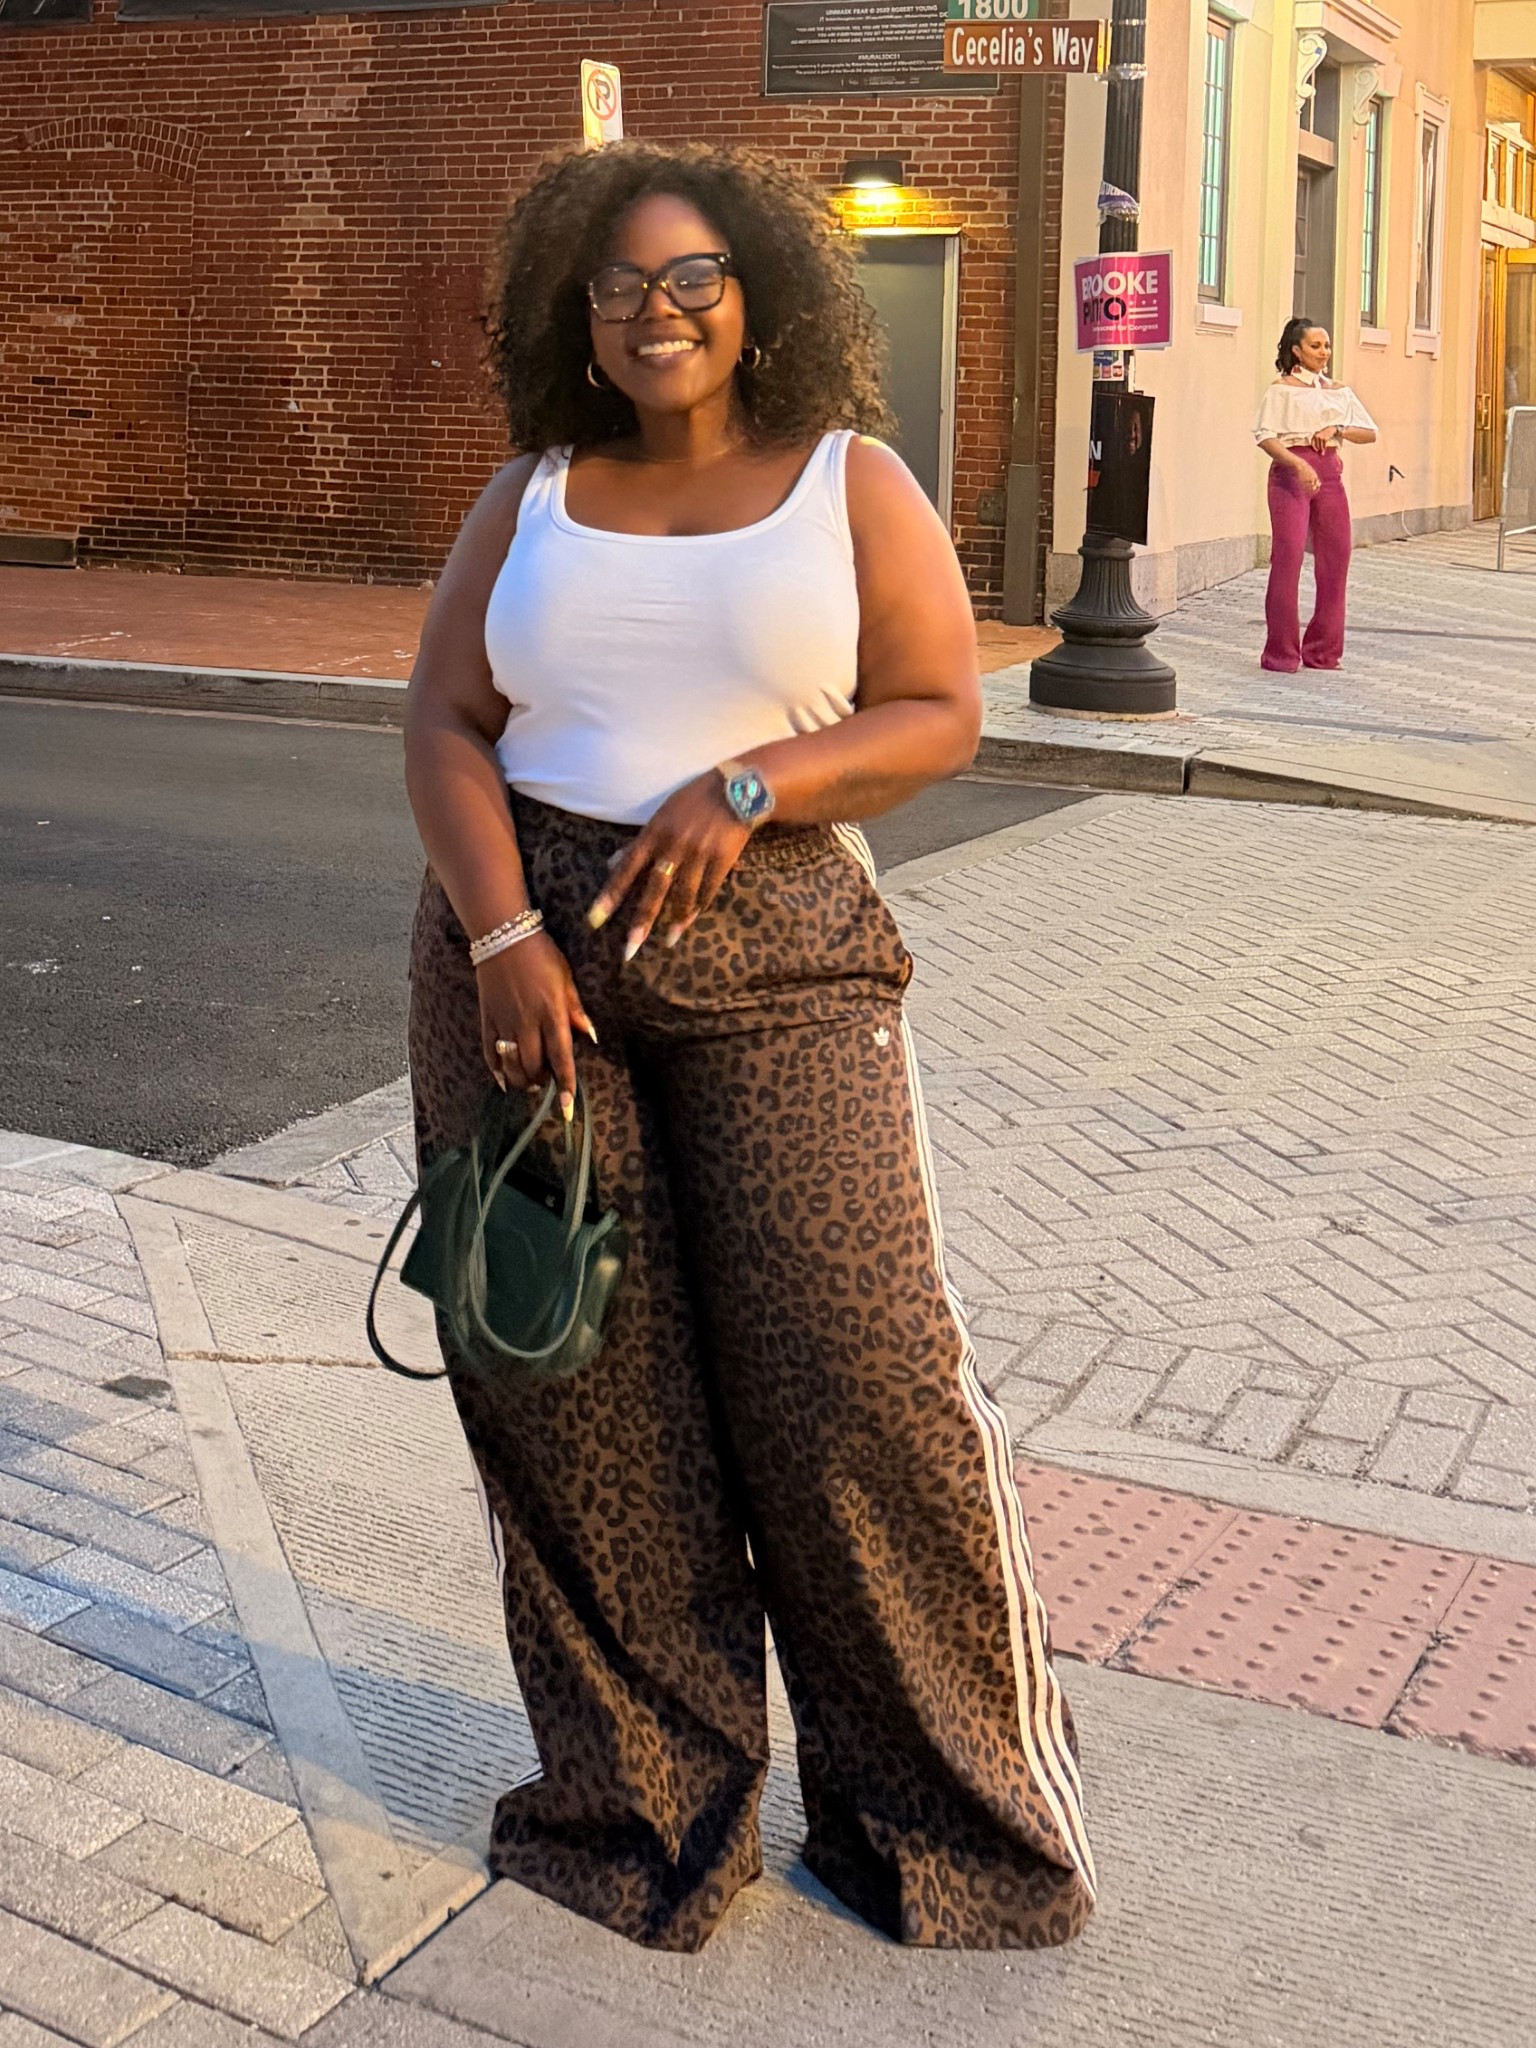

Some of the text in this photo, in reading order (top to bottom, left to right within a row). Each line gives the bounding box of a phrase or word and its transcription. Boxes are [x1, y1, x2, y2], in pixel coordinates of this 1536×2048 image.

[958, 0, 1028, 19] 1800
[952, 26, 1094, 73] Cecelia's Way
[1082, 270, 1158, 300] BROOKE
[1128, 324, 1158, 332] Congress
